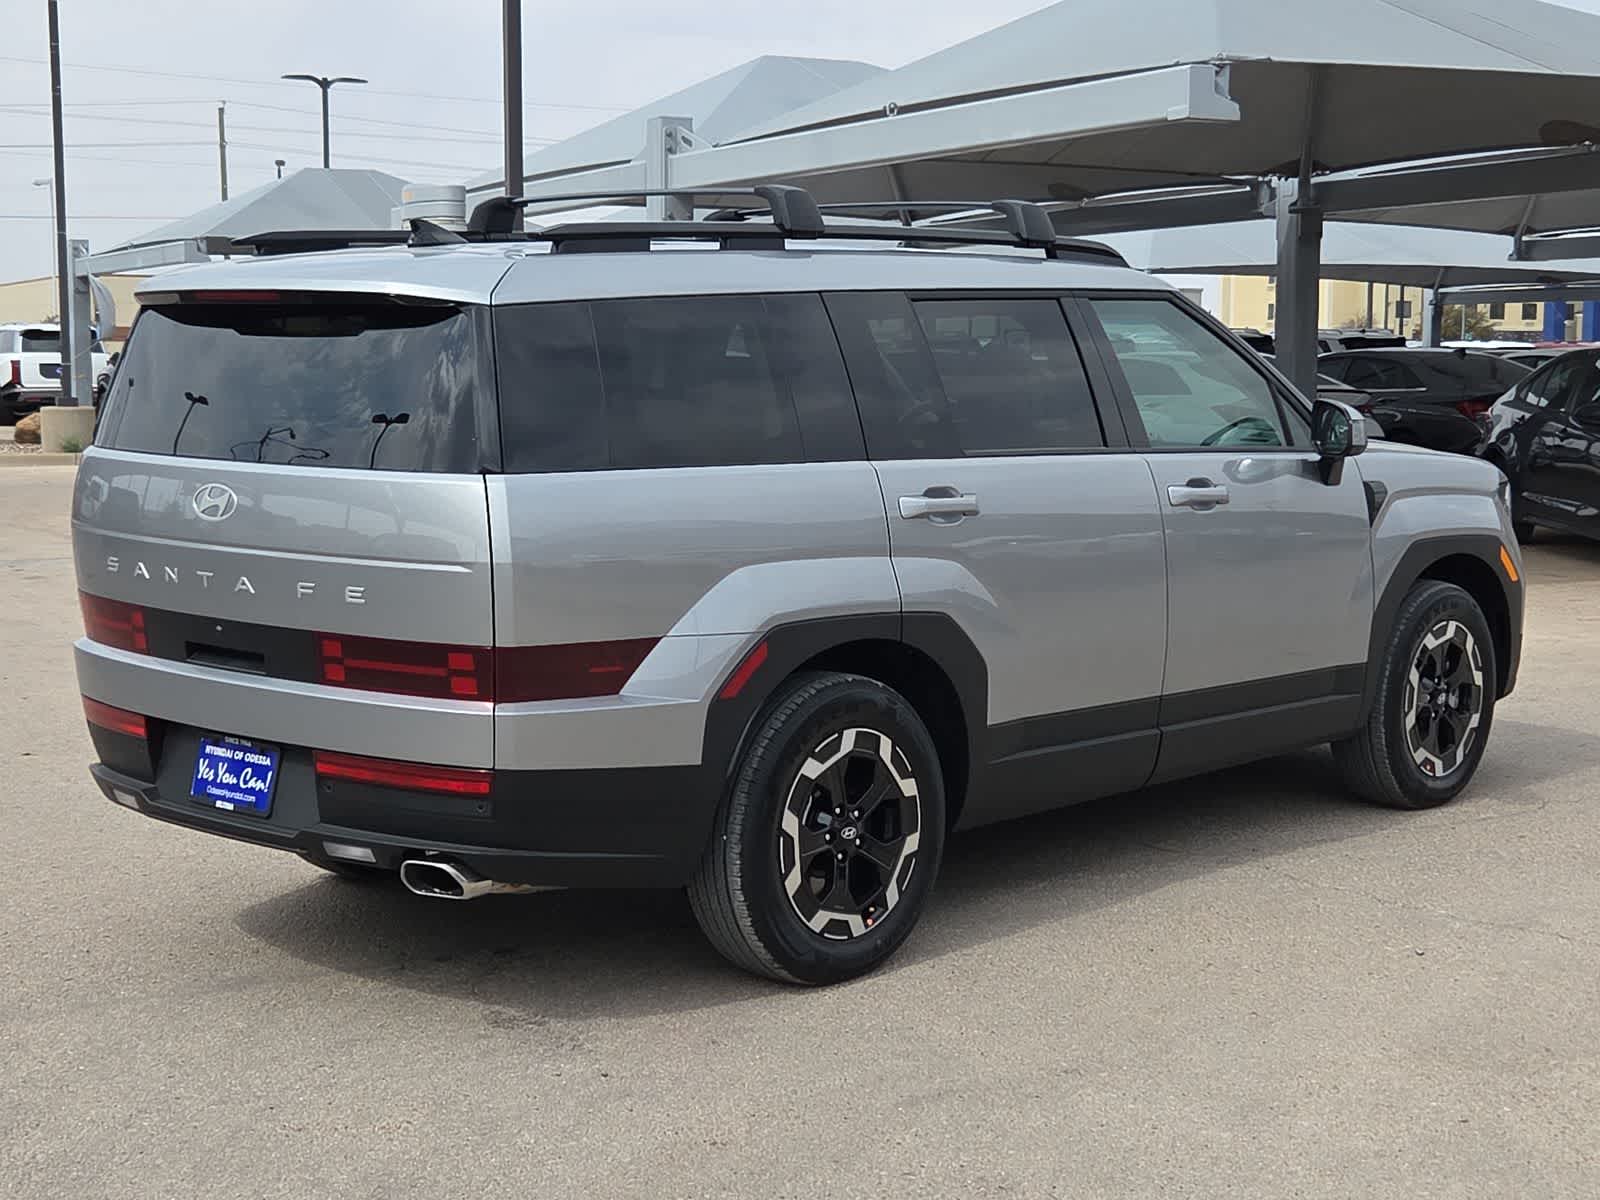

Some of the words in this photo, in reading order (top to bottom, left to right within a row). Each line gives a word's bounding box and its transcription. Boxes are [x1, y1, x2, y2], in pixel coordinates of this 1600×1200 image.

[107, 556, 256, 594] SANTA
[296, 581, 366, 604] FE
[197, 758, 214, 781] Yes
[216, 762, 238, 785] You
[239, 767, 273, 793] Can!
[234, 751, 244, 760] OF
[244, 753, 271, 766] ODESSA
